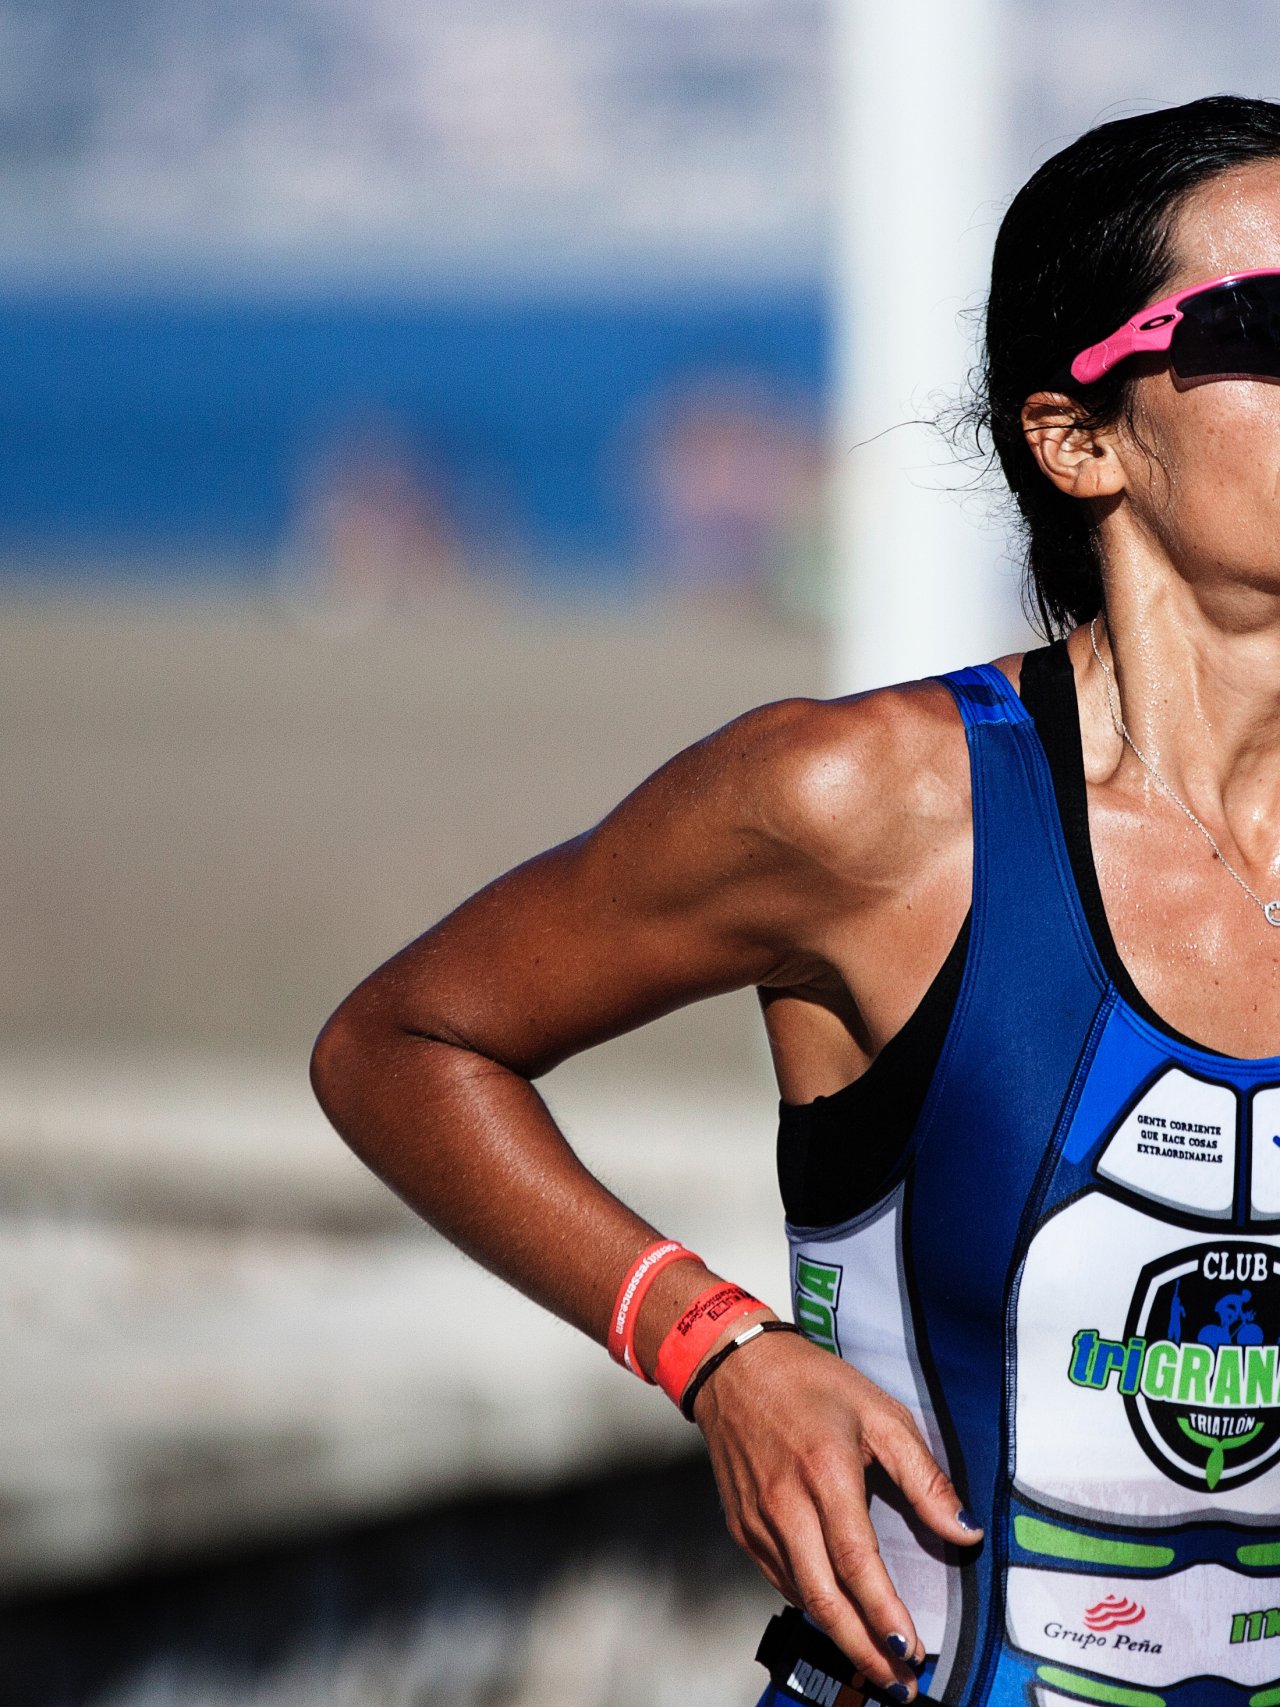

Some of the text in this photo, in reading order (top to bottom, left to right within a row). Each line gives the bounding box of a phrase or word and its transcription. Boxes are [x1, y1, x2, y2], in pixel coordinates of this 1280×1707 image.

[1137, 1115, 1221, 1135] GENTE CORRIENTE
[1141, 1131, 1217, 1149] QUE HACE COSAS
[1137, 1145, 1223, 1163] EXTRAORDINARIAS
[1202, 1251, 1269, 1282] CLUB
[1043, 1622, 1164, 1656] Grupo Peña
